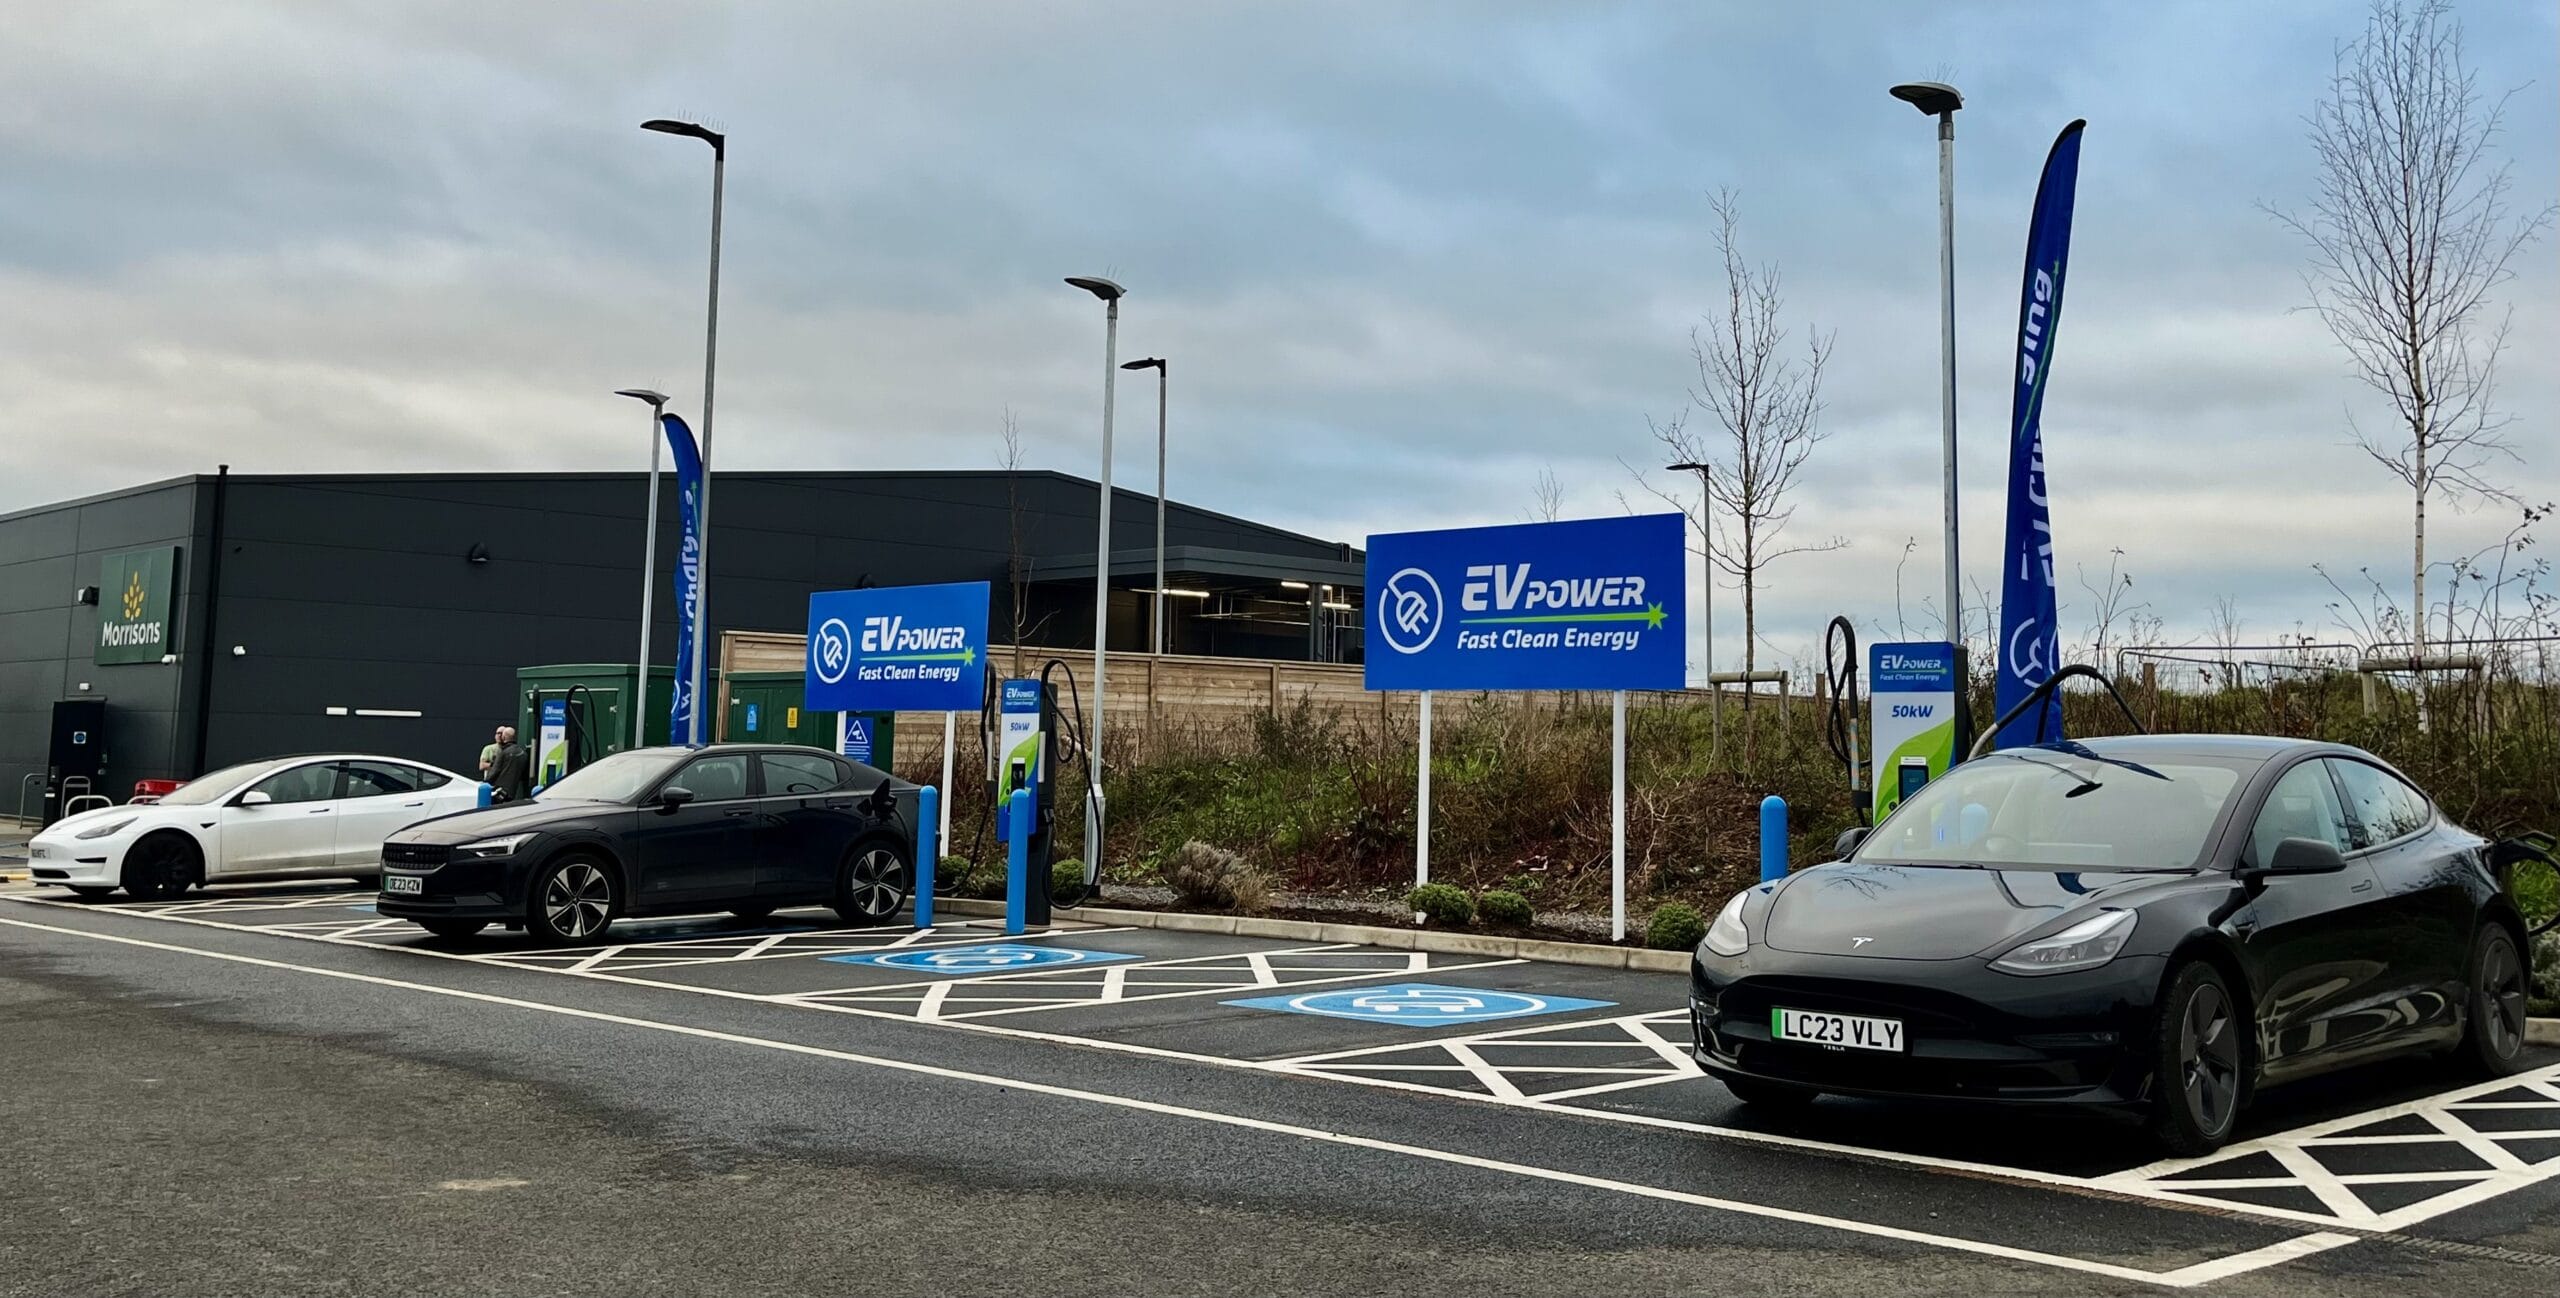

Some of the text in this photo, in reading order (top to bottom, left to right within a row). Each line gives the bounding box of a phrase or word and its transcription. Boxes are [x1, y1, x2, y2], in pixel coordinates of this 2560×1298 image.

[102, 621, 160, 647] Morrisons
[1457, 628, 1639, 651] Fast Clean Energy
[858, 664, 960, 682] Fast Clean Energy
[1892, 705, 1933, 718] 50kW
[1785, 1012, 1899, 1048] LC23 VLY
